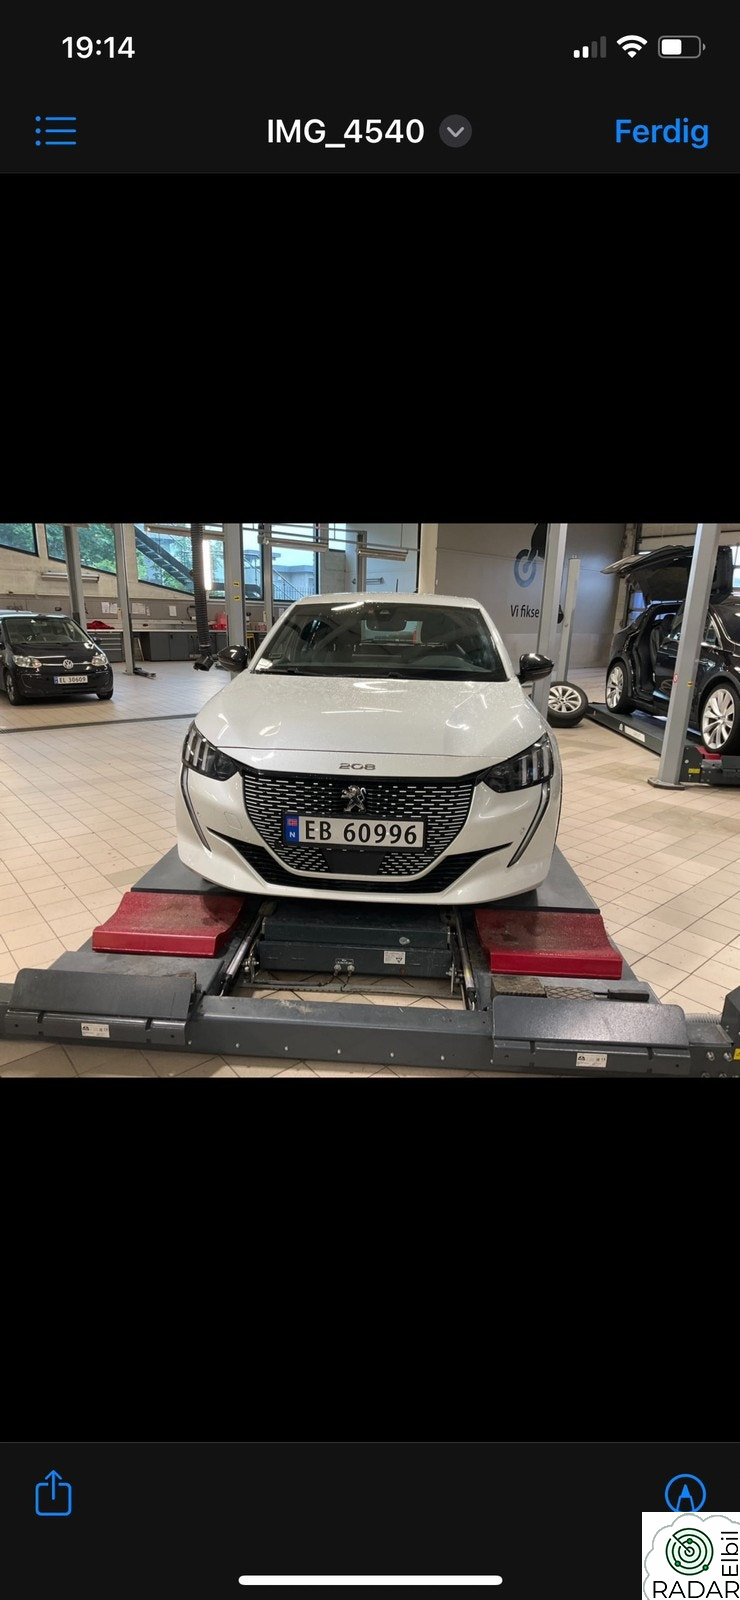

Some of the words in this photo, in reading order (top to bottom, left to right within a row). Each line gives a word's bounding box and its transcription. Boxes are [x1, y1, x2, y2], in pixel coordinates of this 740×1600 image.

[62, 36, 136, 59] 19:14
[266, 118, 425, 149] IMG_4540
[614, 118, 710, 150] Ferdig
[510, 604, 519, 617] Vi
[338, 762, 376, 771] 208
[288, 831, 296, 839] N
[304, 820, 332, 841] EB
[343, 822, 418, 845] 60996
